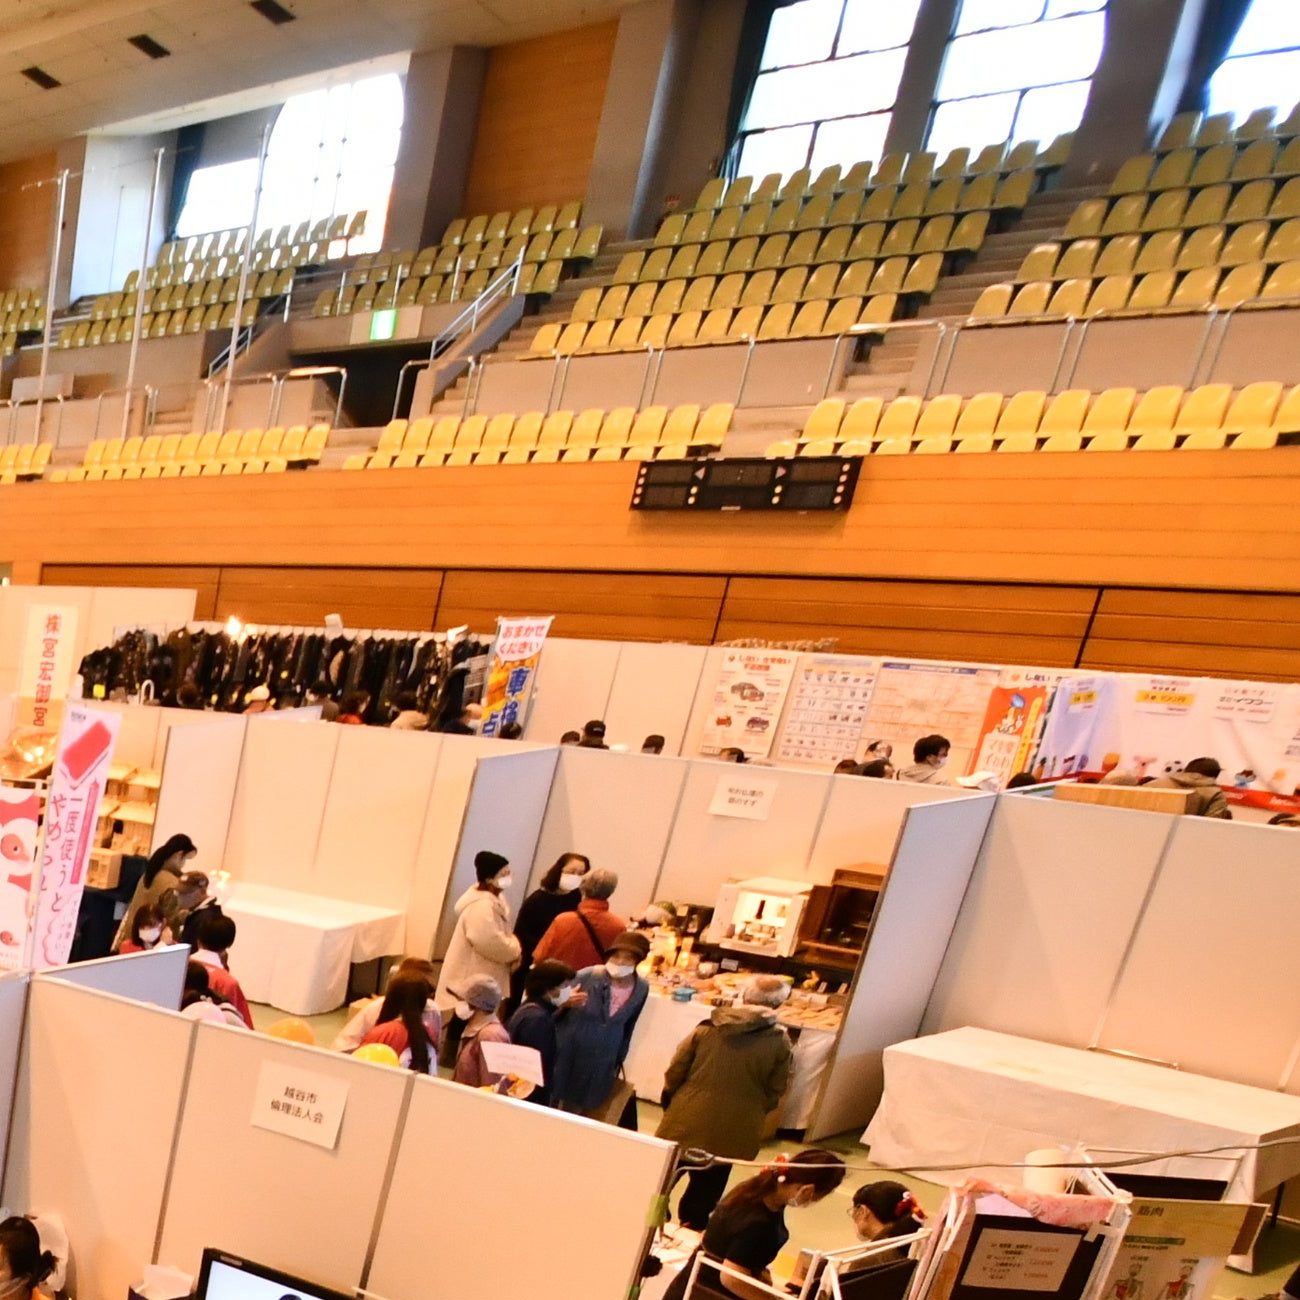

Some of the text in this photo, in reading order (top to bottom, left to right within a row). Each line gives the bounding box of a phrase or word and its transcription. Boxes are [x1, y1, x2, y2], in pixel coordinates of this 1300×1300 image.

[502, 625, 545, 639] おまかせ
[499, 642, 539, 655] ください
[49, 794, 83, 913] 一度使うと
[284, 1086, 318, 1105] 越谷市
[270, 1098, 324, 1125] 倫理法人会
